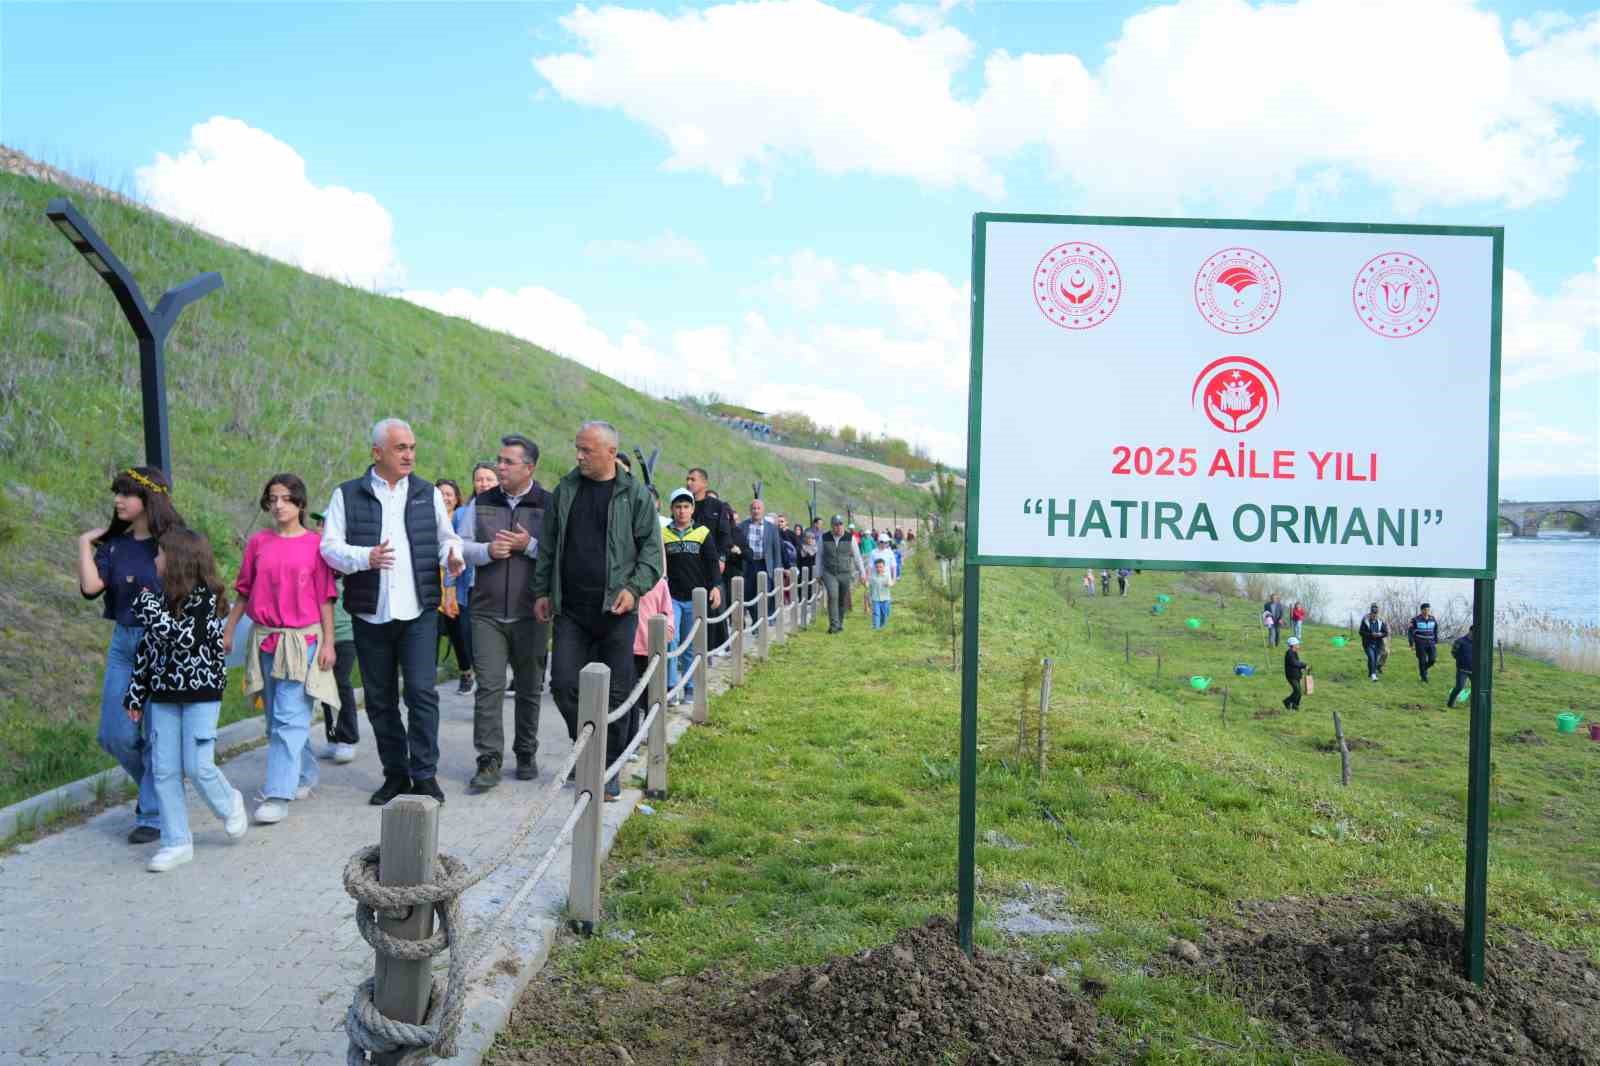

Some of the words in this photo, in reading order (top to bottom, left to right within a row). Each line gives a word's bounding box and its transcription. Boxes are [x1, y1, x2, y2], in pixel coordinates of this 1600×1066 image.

[1111, 446, 1198, 477] 2025
[1208, 441, 1296, 480] AİLE
[1308, 451, 1378, 482] YILI
